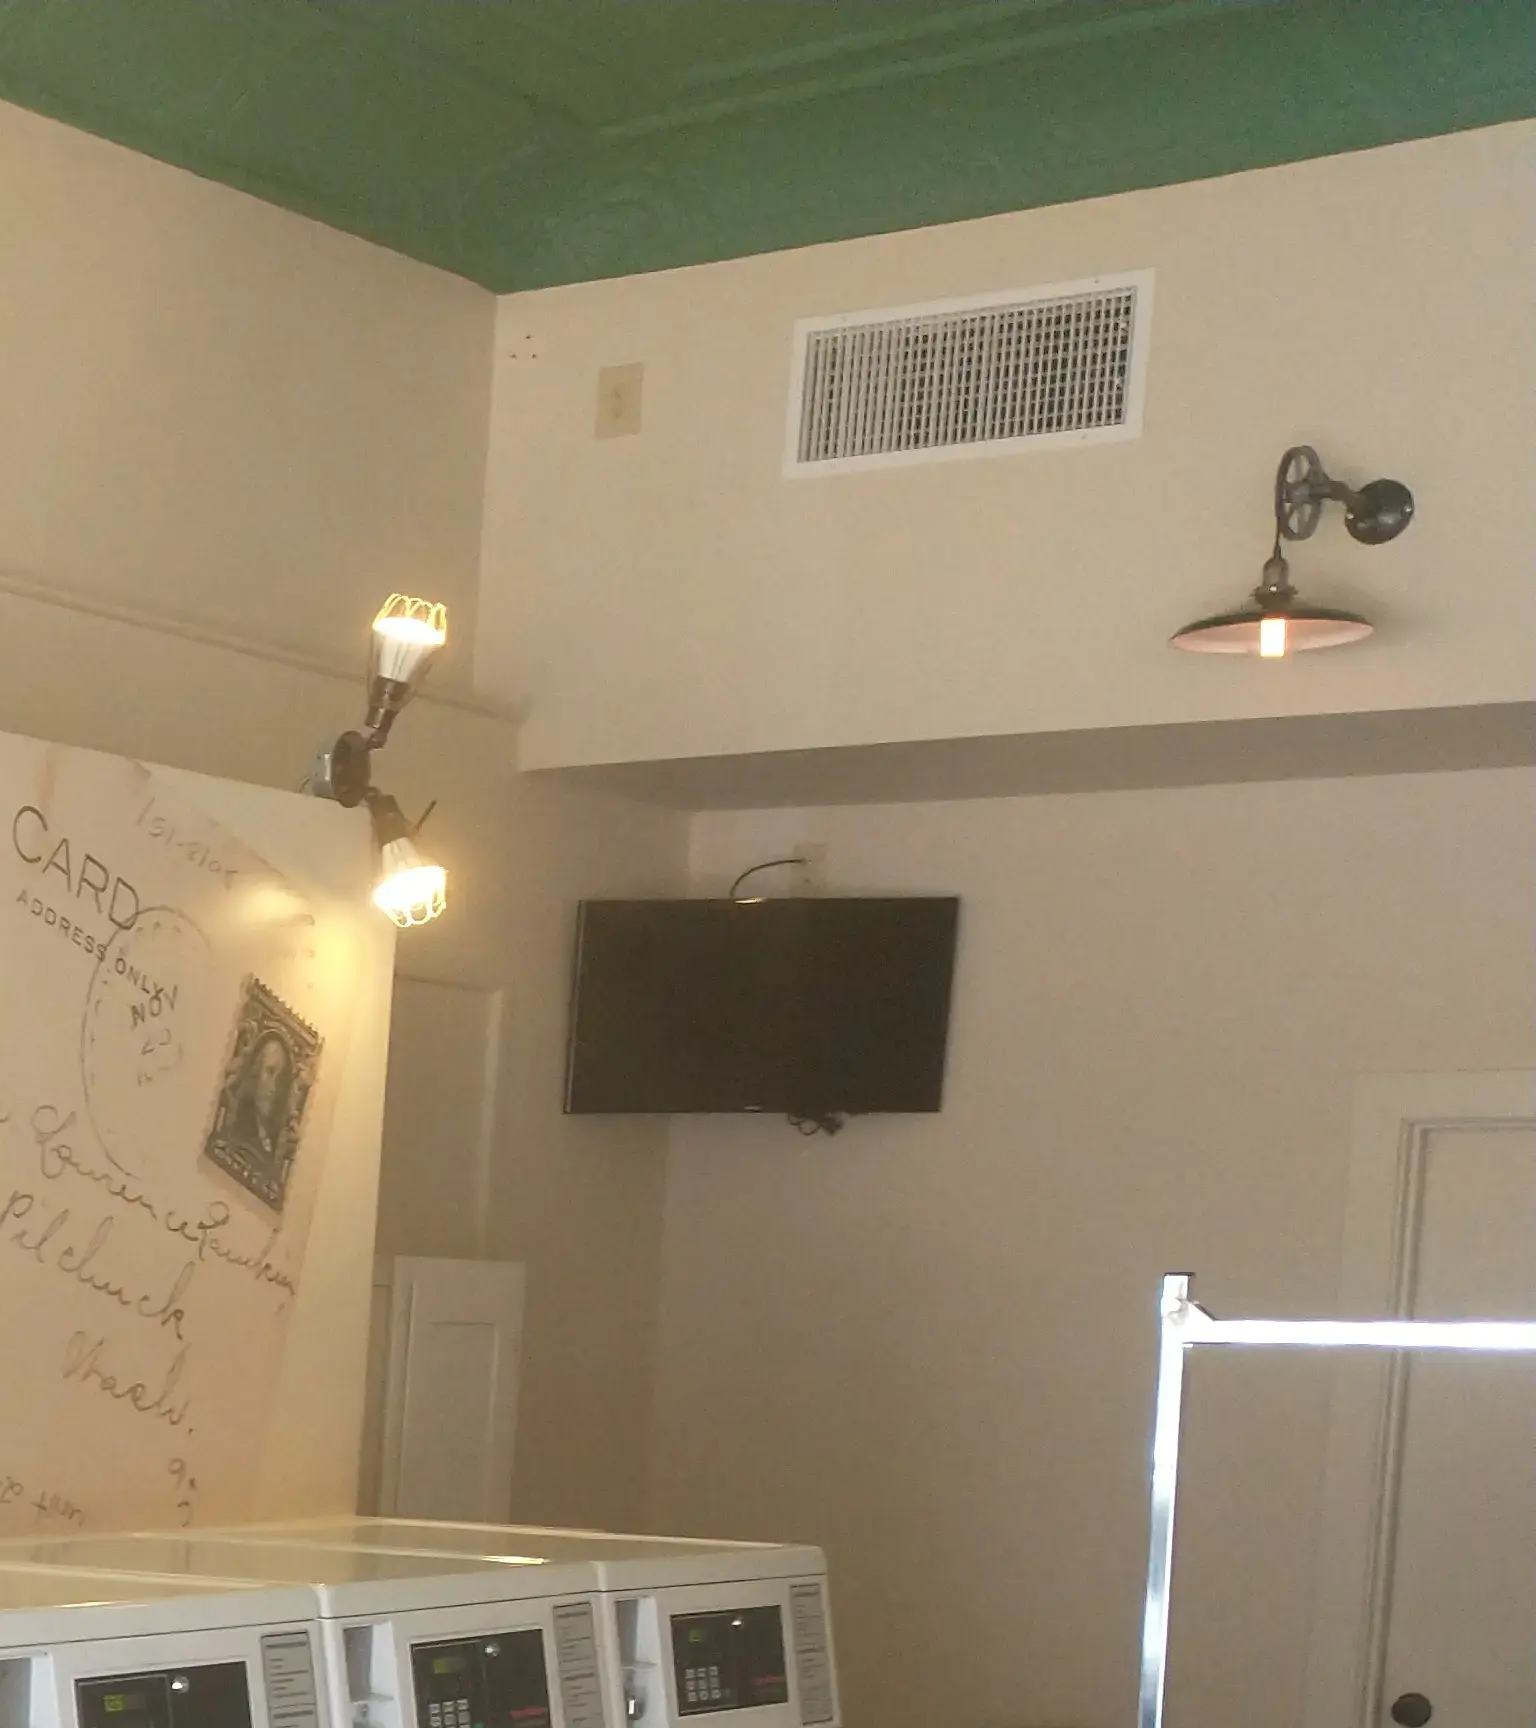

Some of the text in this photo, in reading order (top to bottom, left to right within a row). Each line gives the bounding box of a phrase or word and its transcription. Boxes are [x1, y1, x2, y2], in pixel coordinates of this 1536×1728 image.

[12, 804, 141, 932] CARD
[15, 888, 108, 963] ADDRESS
[130, 984, 178, 1029] NOV
